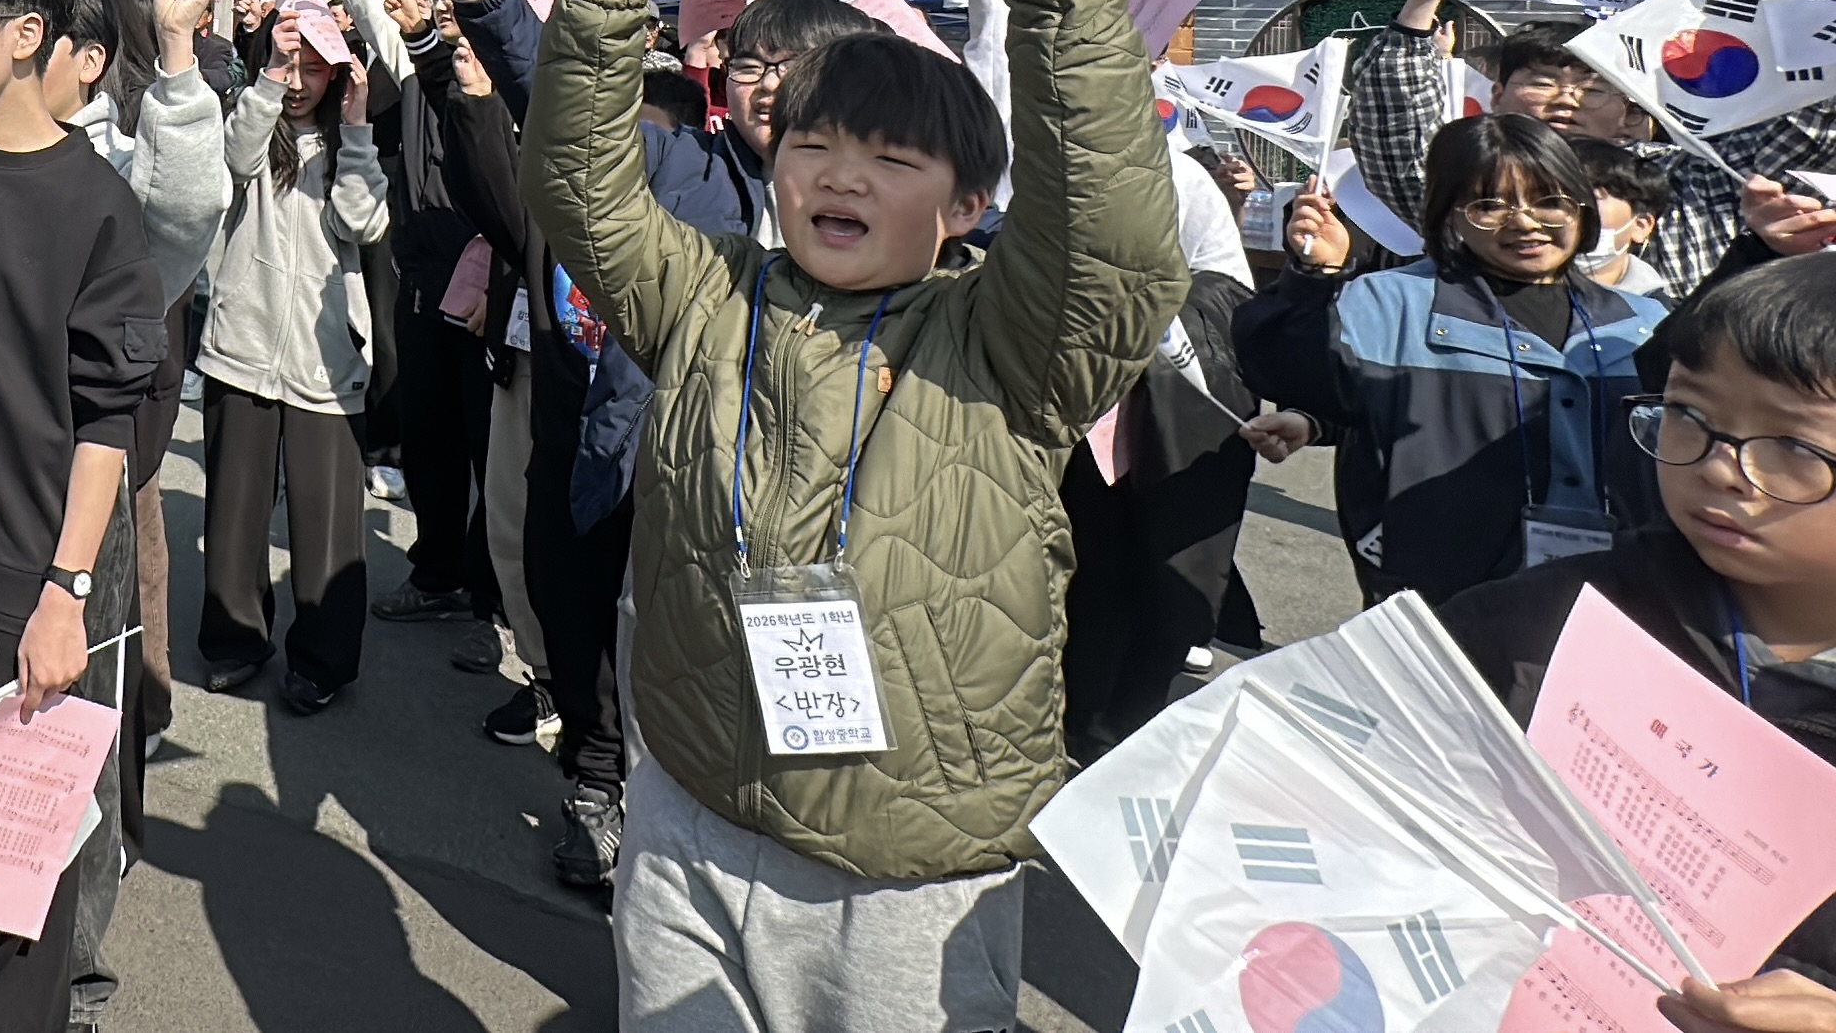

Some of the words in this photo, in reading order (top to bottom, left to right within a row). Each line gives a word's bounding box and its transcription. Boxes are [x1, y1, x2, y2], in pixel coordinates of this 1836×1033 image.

[746, 612, 815, 628] 2026학년도
[822, 610, 855, 623] 1학년
[775, 653, 847, 680] 우광현
